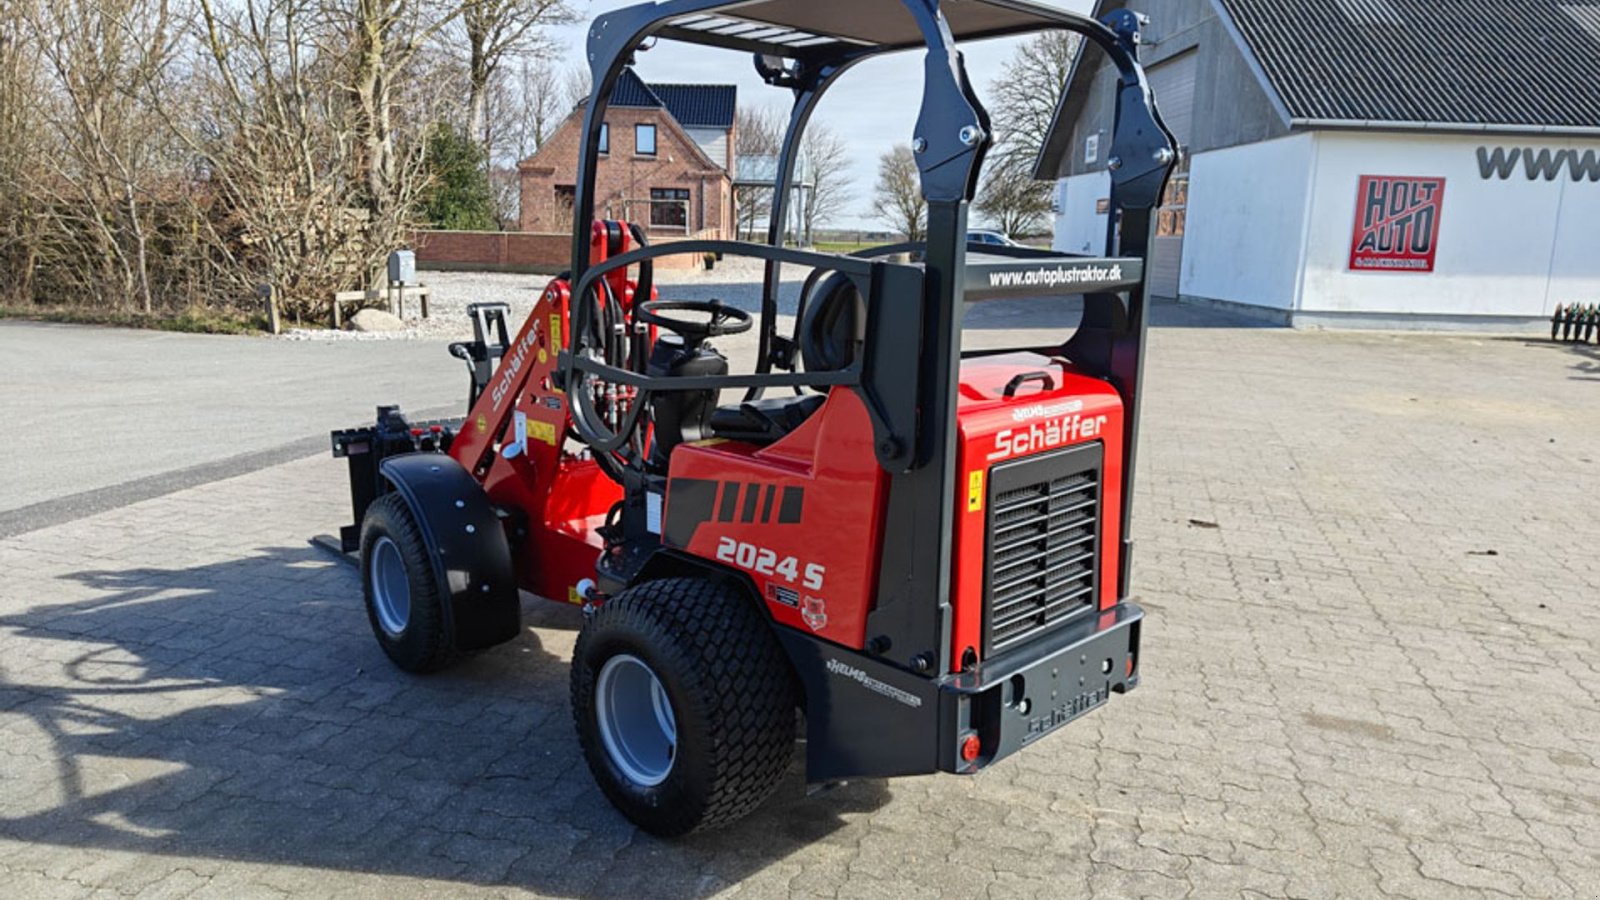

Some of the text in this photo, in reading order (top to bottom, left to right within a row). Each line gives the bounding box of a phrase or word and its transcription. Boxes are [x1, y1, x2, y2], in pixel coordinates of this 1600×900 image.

[1355, 203, 1436, 254] AUTO
[1363, 180, 1439, 230] HOLT
[989, 263, 1122, 287] www.autoplustraktor.dk
[490, 318, 541, 412] Schäffer
[986, 414, 1107, 461] Schäffer
[716, 535, 826, 591] 2024 S
